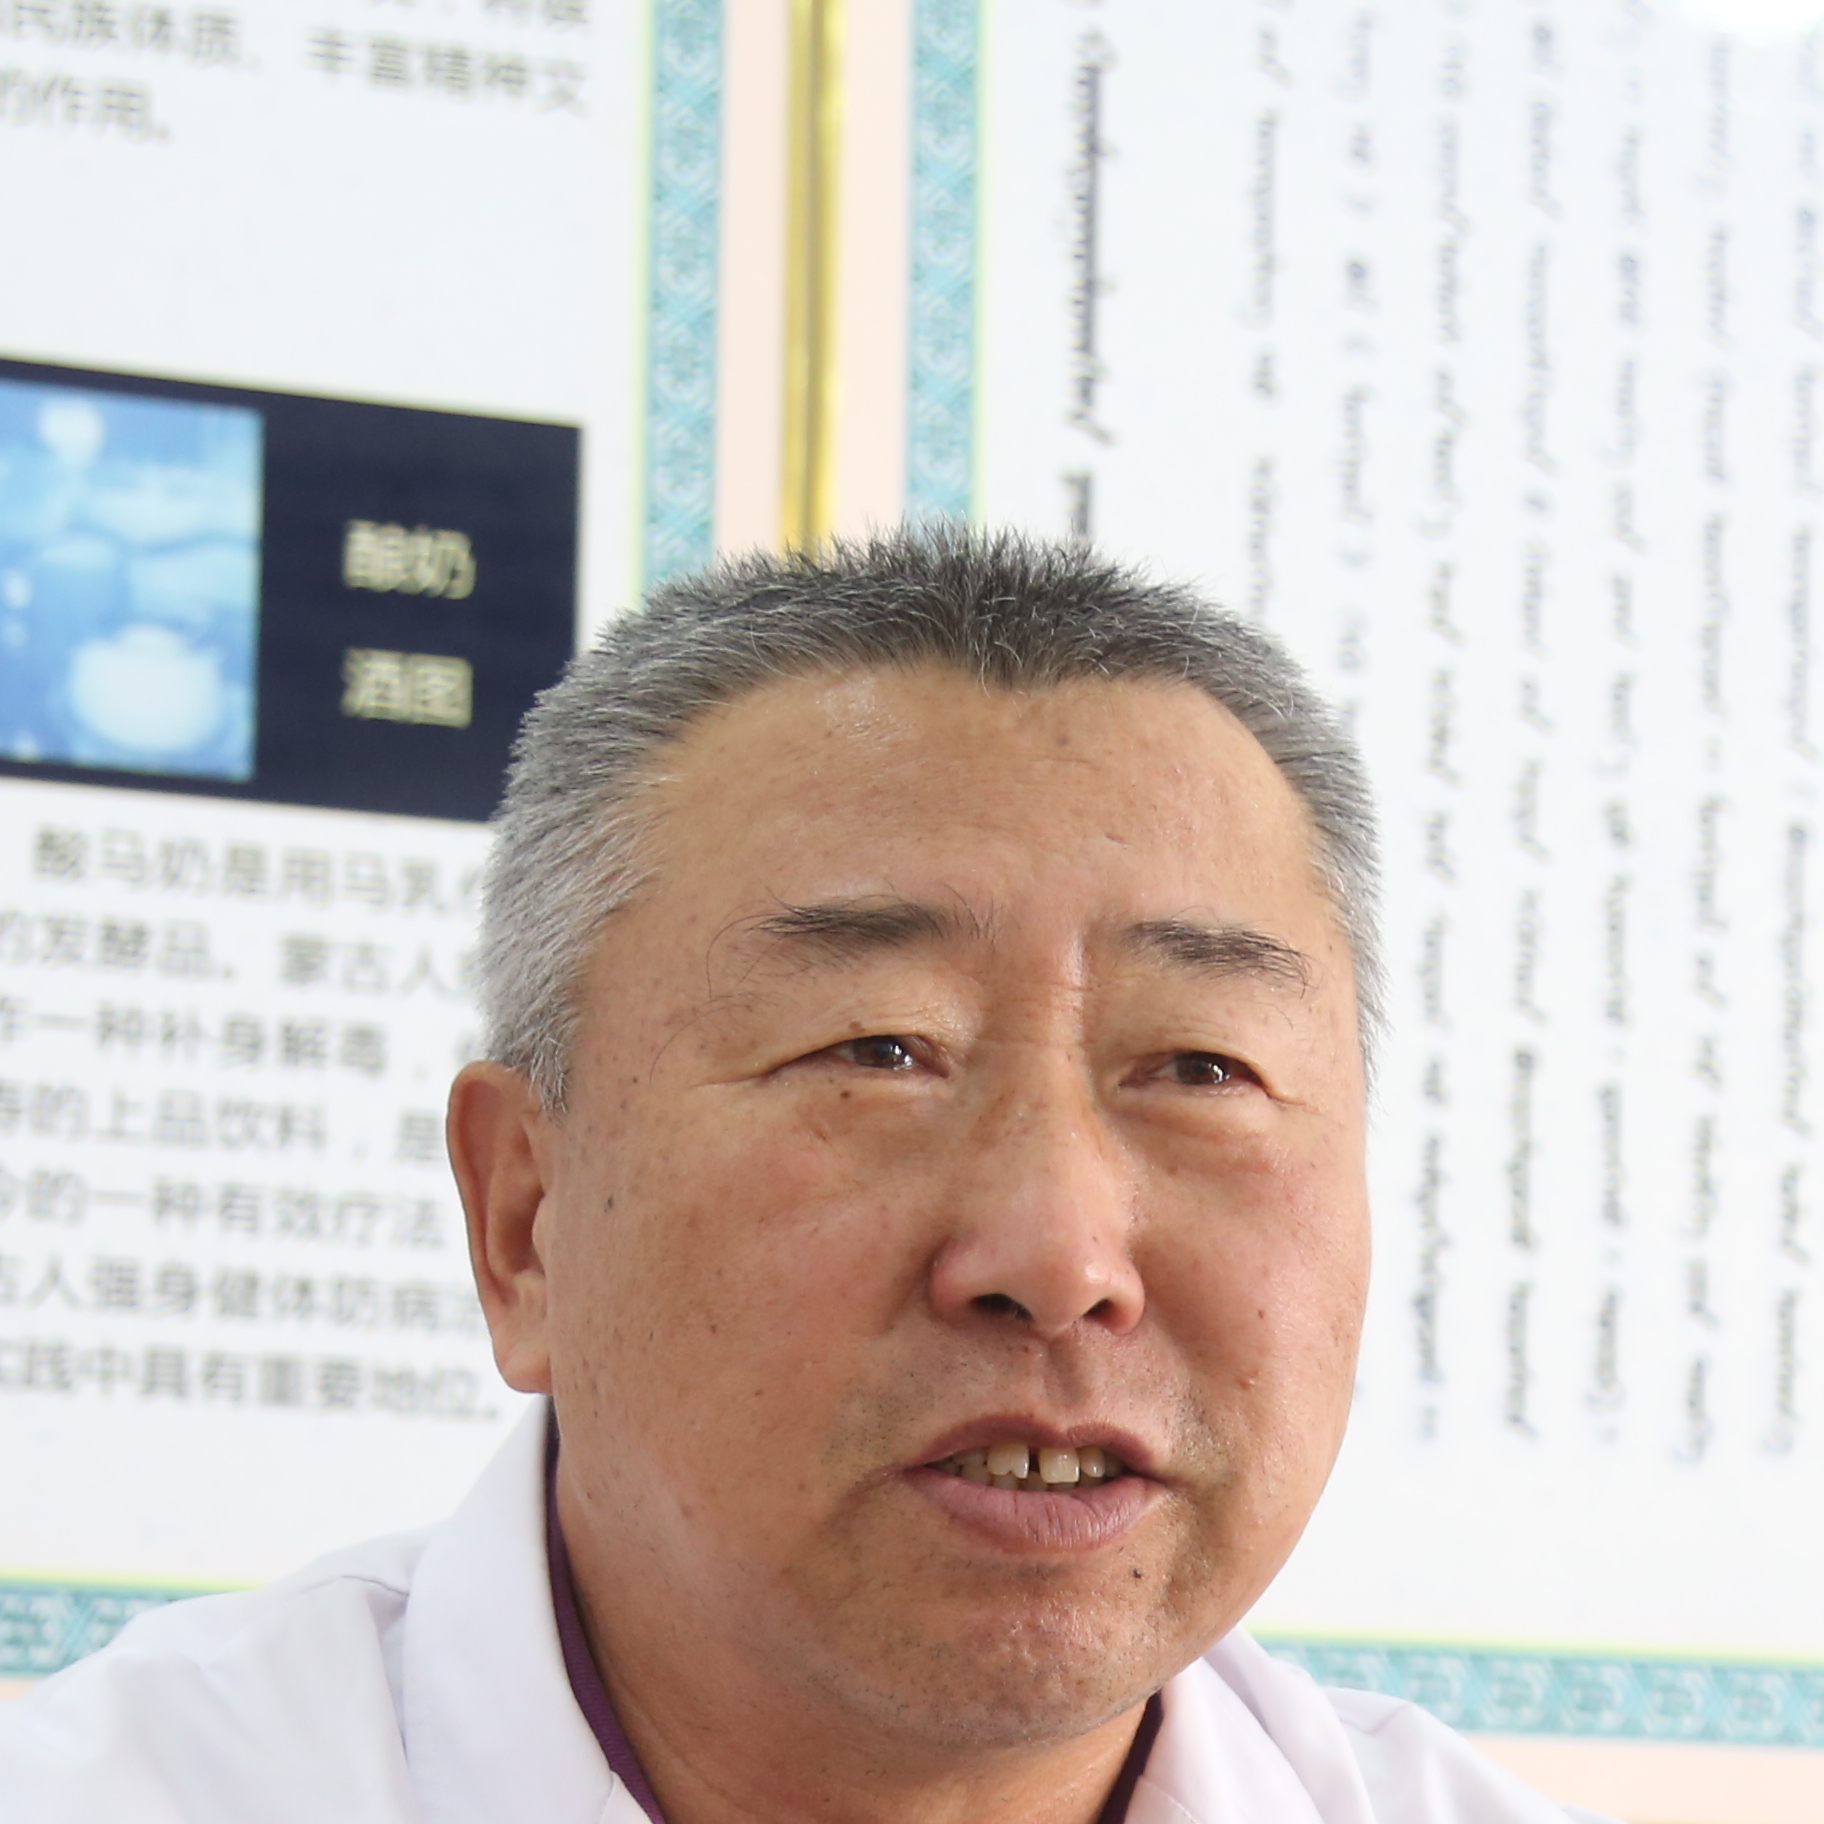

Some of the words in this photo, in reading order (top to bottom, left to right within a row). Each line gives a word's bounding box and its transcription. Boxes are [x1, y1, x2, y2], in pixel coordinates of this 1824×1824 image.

[33, 824, 480, 920] 酸马奶是用马乳
